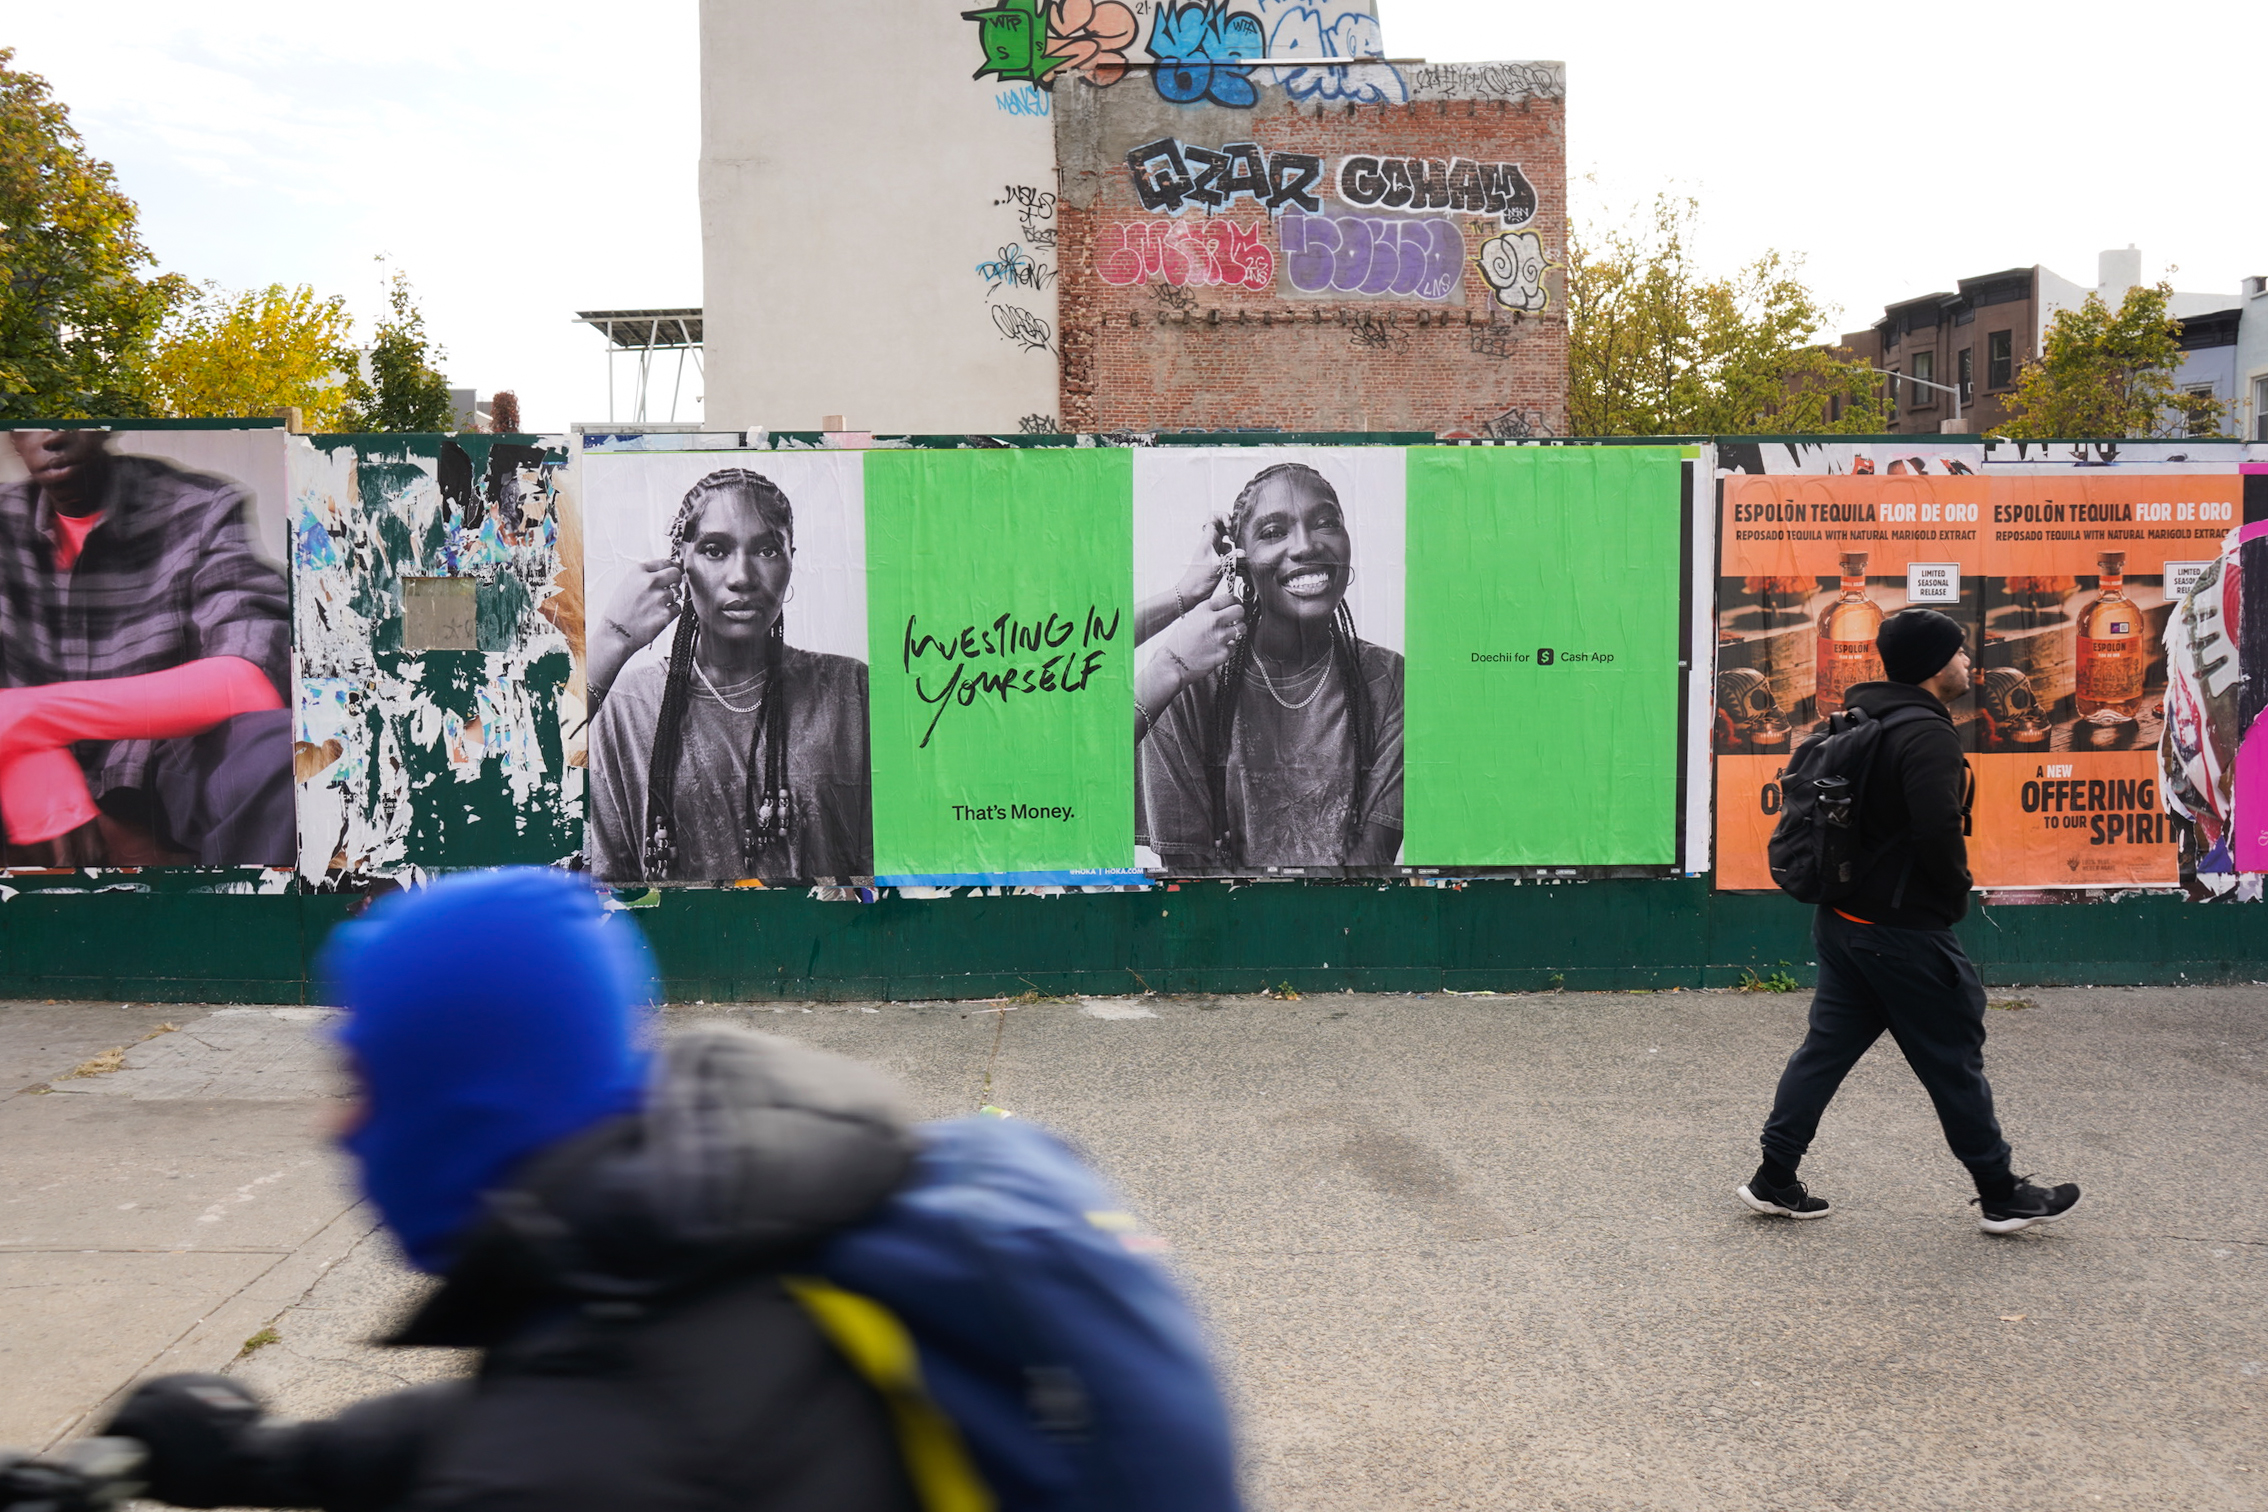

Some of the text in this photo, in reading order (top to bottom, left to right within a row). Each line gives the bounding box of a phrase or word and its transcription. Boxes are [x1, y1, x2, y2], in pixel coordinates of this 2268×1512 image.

[1810, 503, 1876, 523] TEQUILA
[1880, 503, 1916, 522] FLOR
[1921, 503, 1941, 522] DE
[1945, 503, 1979, 522] ORO
[2069, 503, 2132, 522] TEQUILA
[2136, 503, 2172, 521] FLOR
[2176, 502, 2196, 521] DE
[2199, 502, 2233, 521] ORO
[1736, 530, 1977, 541] REPOSADO TEQUILA WITH NATURAL MARIGOLD EXTRACT
[1996, 530, 2043, 541] REPOSADO
[2045, 530, 2081, 541] TEQUILA
[2083, 529, 2105, 540] WITH
[2107, 529, 2145, 540] NATURAL
[2148, 529, 2192, 539] MARIGOLD
[1921, 570, 1946, 578] LIMITED
[2177, 568, 2200, 576] LIMITED
[1917, 579, 1949, 587] SEASONAL
[1920, 588, 1947, 596] RELEASE
[1083, 604, 1119, 648] IN
[1471, 652, 1512, 663] Doechii
[1515, 652, 1530, 662] for
[1560, 652, 1588, 662] Cash
[1591, 652, 1615, 664] App
[2036, 764, 2073, 778] A NEW
[2021, 779, 2155, 813] OFFERING
[1011, 804, 1075, 823] Money.
[2044, 815, 2060, 829] TO
[2062, 815, 2087, 829] OUR
[1104, 867, 1144, 875] HOKA.COM
